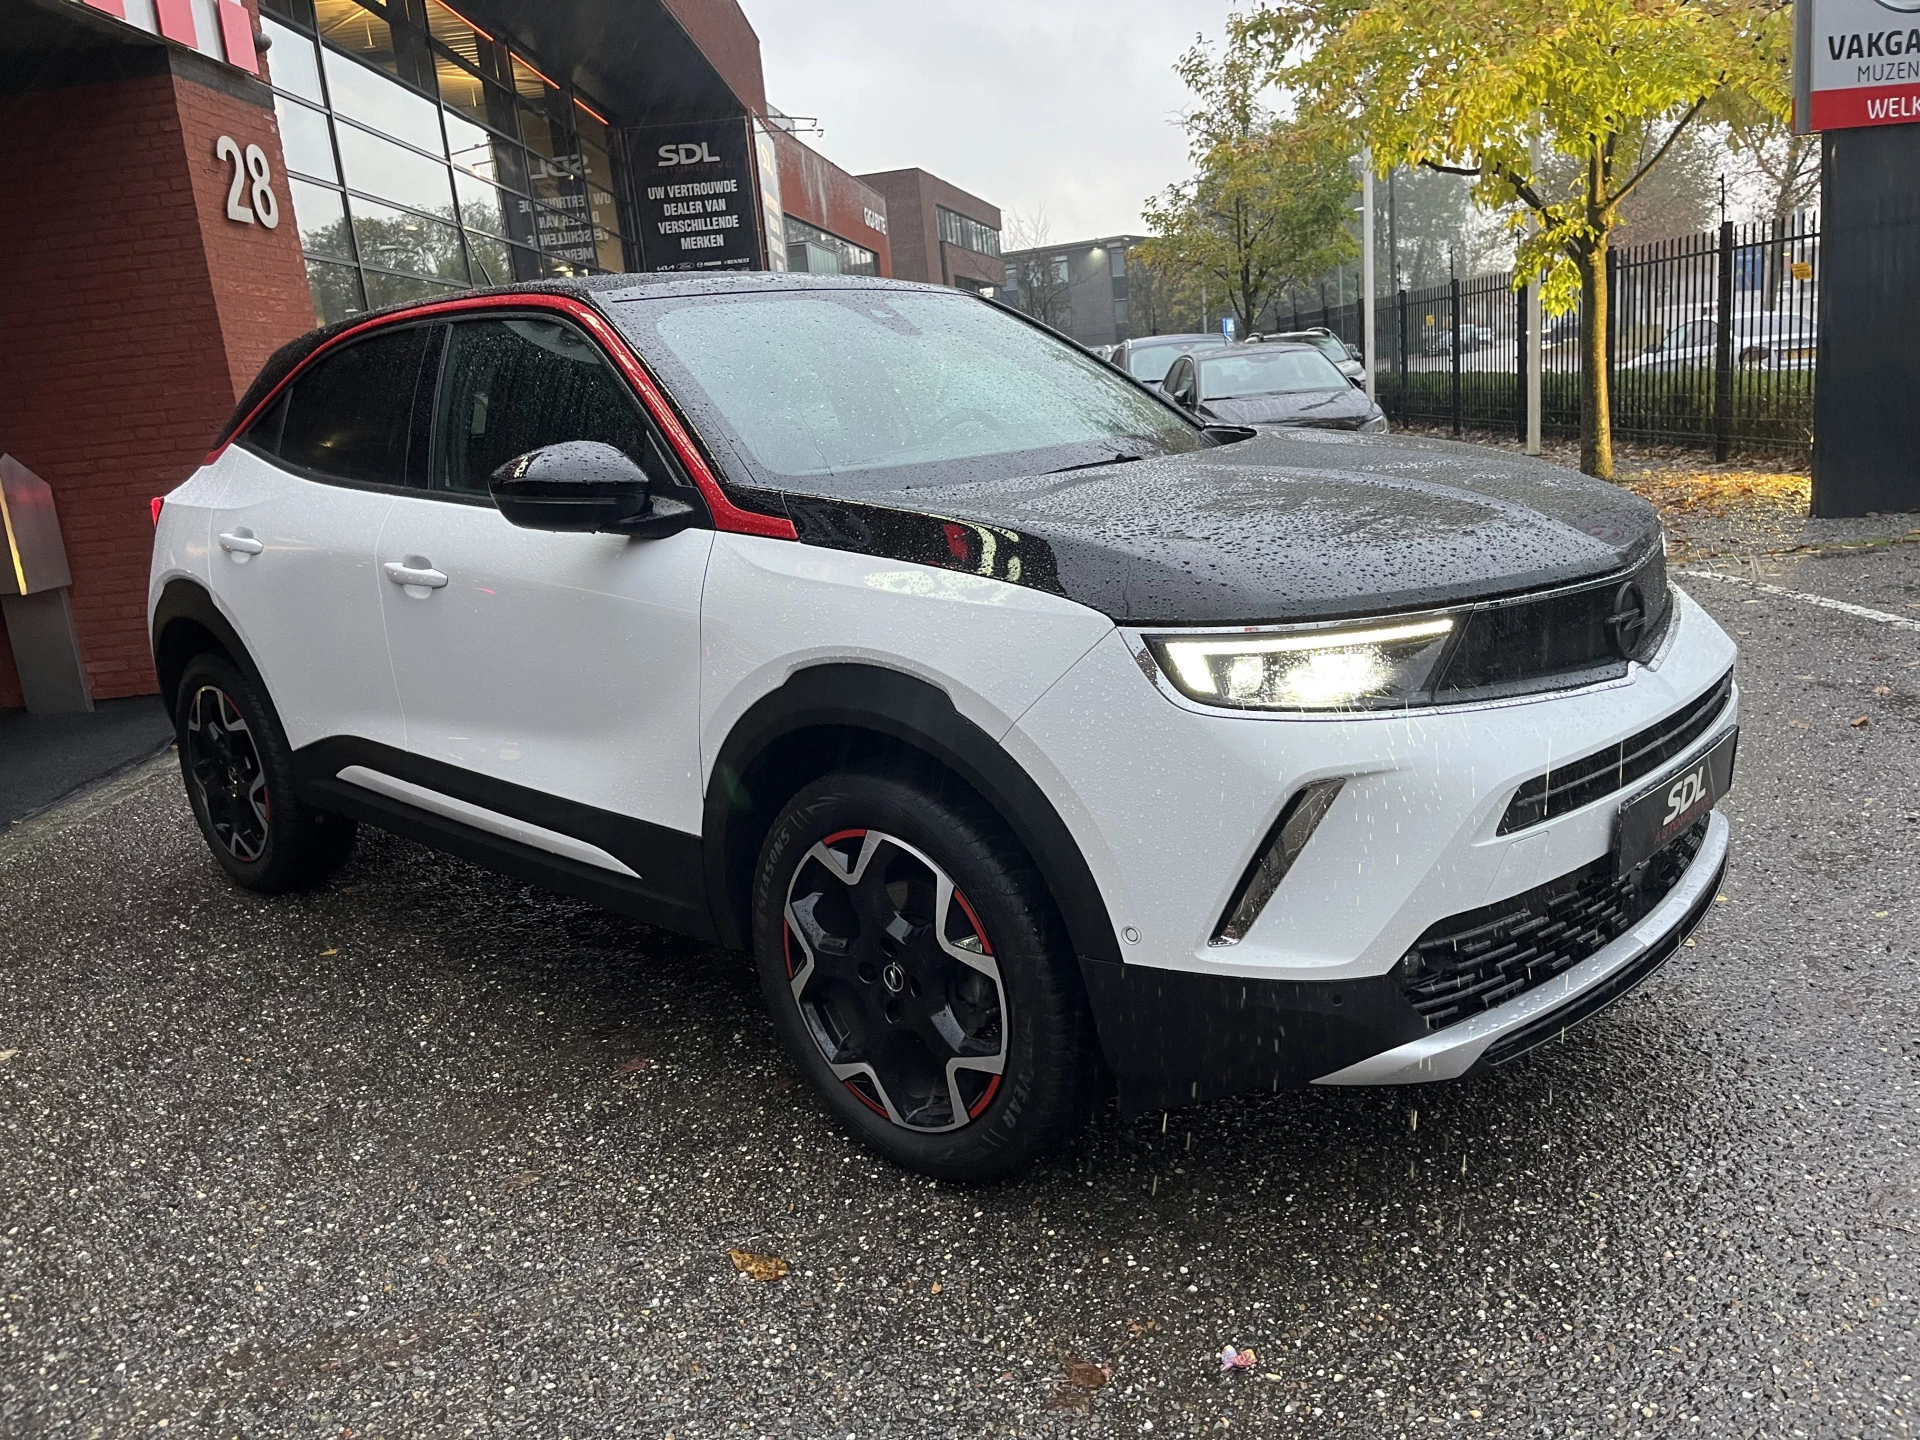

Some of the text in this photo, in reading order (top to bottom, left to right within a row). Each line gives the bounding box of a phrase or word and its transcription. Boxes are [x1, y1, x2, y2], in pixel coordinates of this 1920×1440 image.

[1828, 28, 1920, 60] VAKGA
[1857, 61, 1919, 82] MUZEN
[1867, 96, 1920, 119] WELK
[658, 142, 720, 167] SDL
[217, 135, 279, 229] 28
[648, 179, 738, 200] UW VERTROUWDE
[663, 198, 727, 216] DEALER VAN
[658, 215, 740, 234] VERSCHILLENDE
[680, 234, 725, 250] MERKEN
[1663, 765, 1706, 826] SDL
